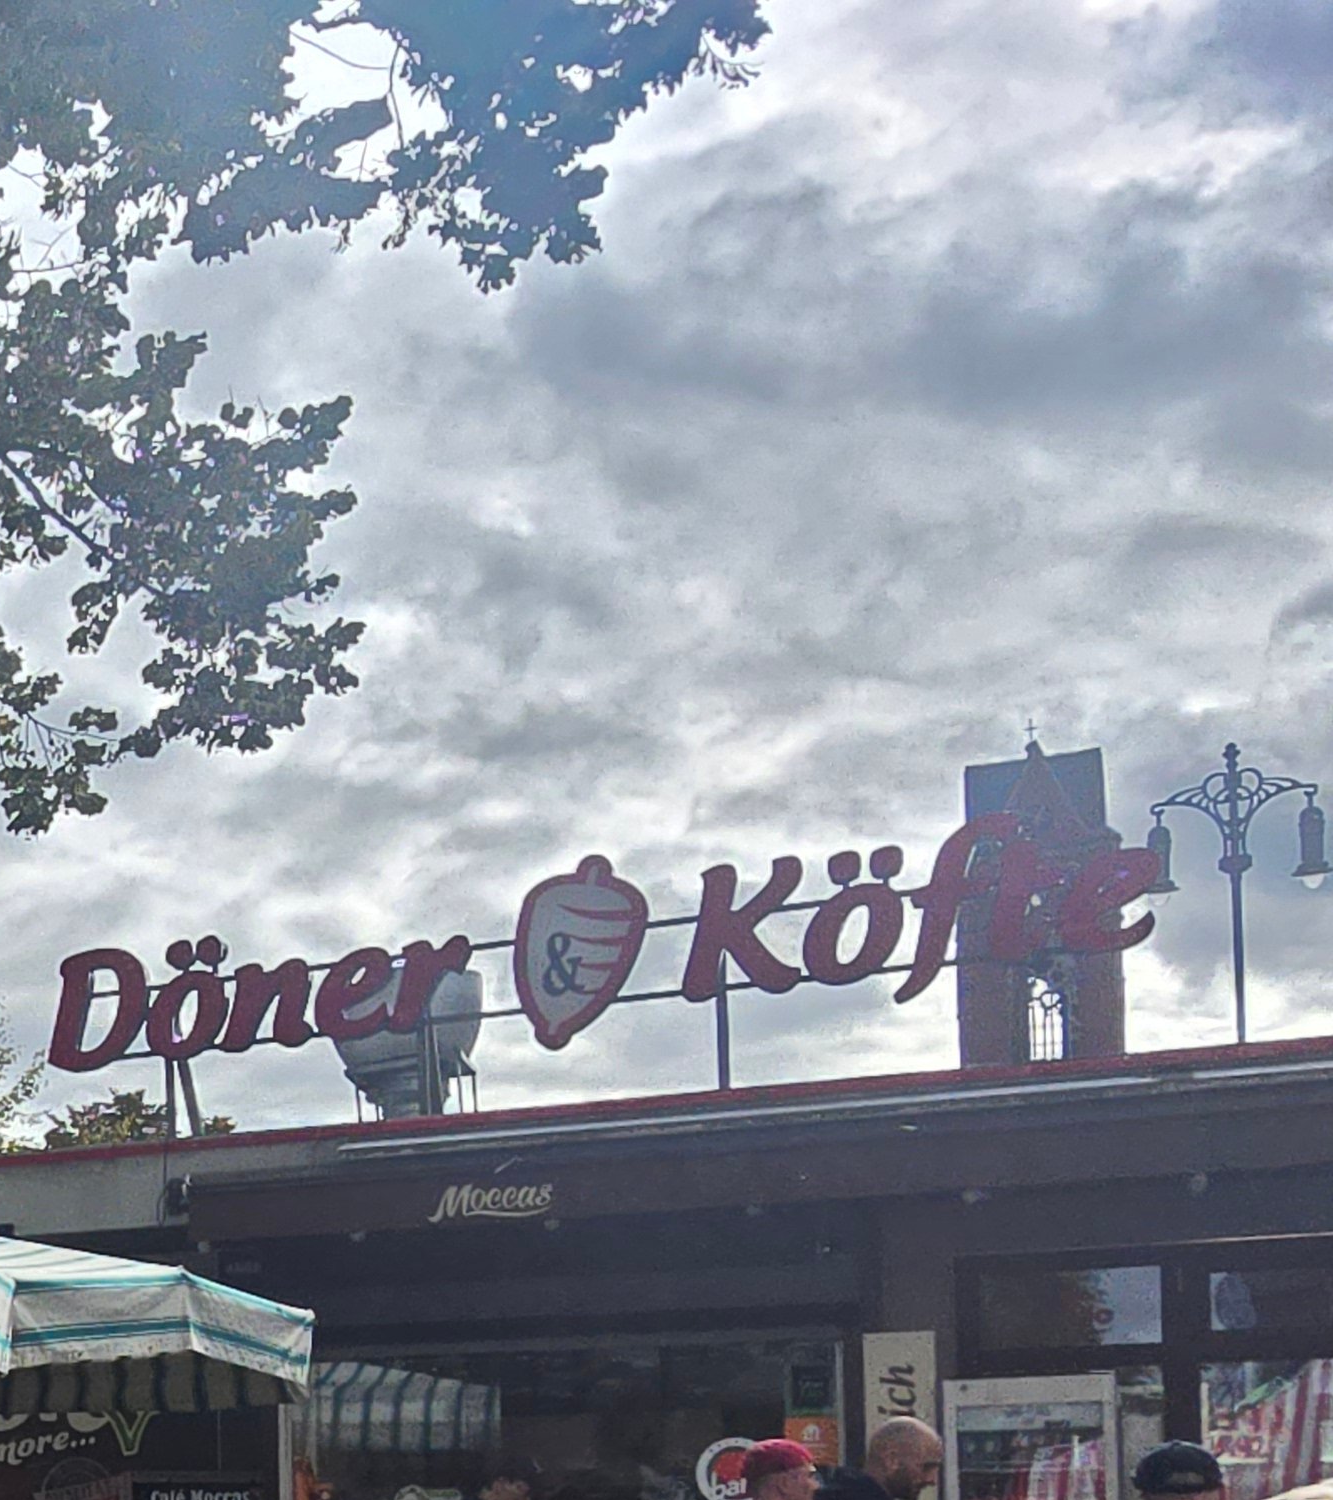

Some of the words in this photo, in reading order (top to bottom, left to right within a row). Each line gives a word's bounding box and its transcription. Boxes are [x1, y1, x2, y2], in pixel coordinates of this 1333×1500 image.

[48, 934, 473, 1073] Döner
[541, 932, 586, 997] &
[682, 811, 1162, 1005] Köfte
[426, 1182, 554, 1224] Moccas
